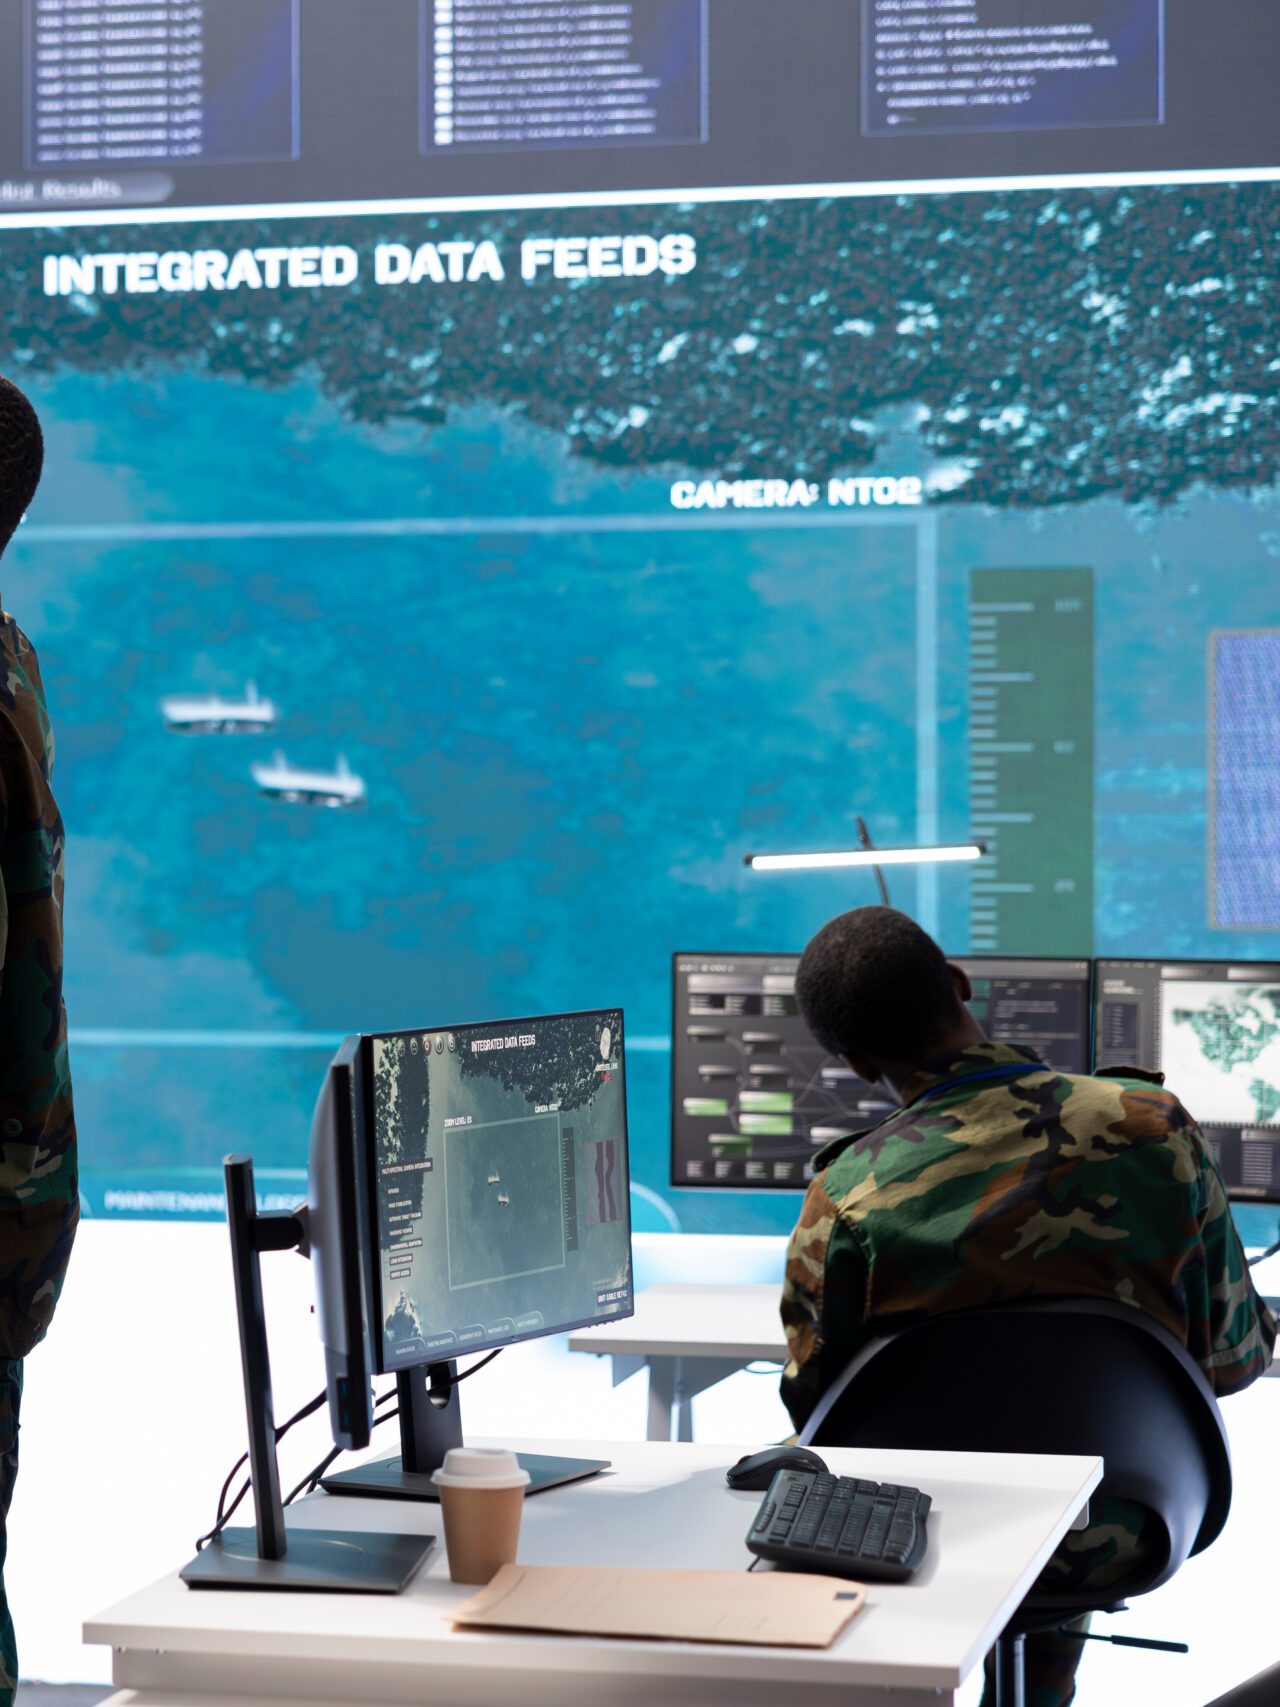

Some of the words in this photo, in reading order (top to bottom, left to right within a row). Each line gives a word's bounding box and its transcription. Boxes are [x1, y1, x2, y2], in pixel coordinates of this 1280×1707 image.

[42, 245, 358, 296] INTEGRATED
[374, 241, 505, 285] DATA
[521, 235, 696, 280] FEEDS
[670, 479, 819, 508] CAMERA:
[471, 1038, 503, 1053] INTEGRATED
[504, 1036, 518, 1049] DATA
[518, 1034, 536, 1047] FEEDS
